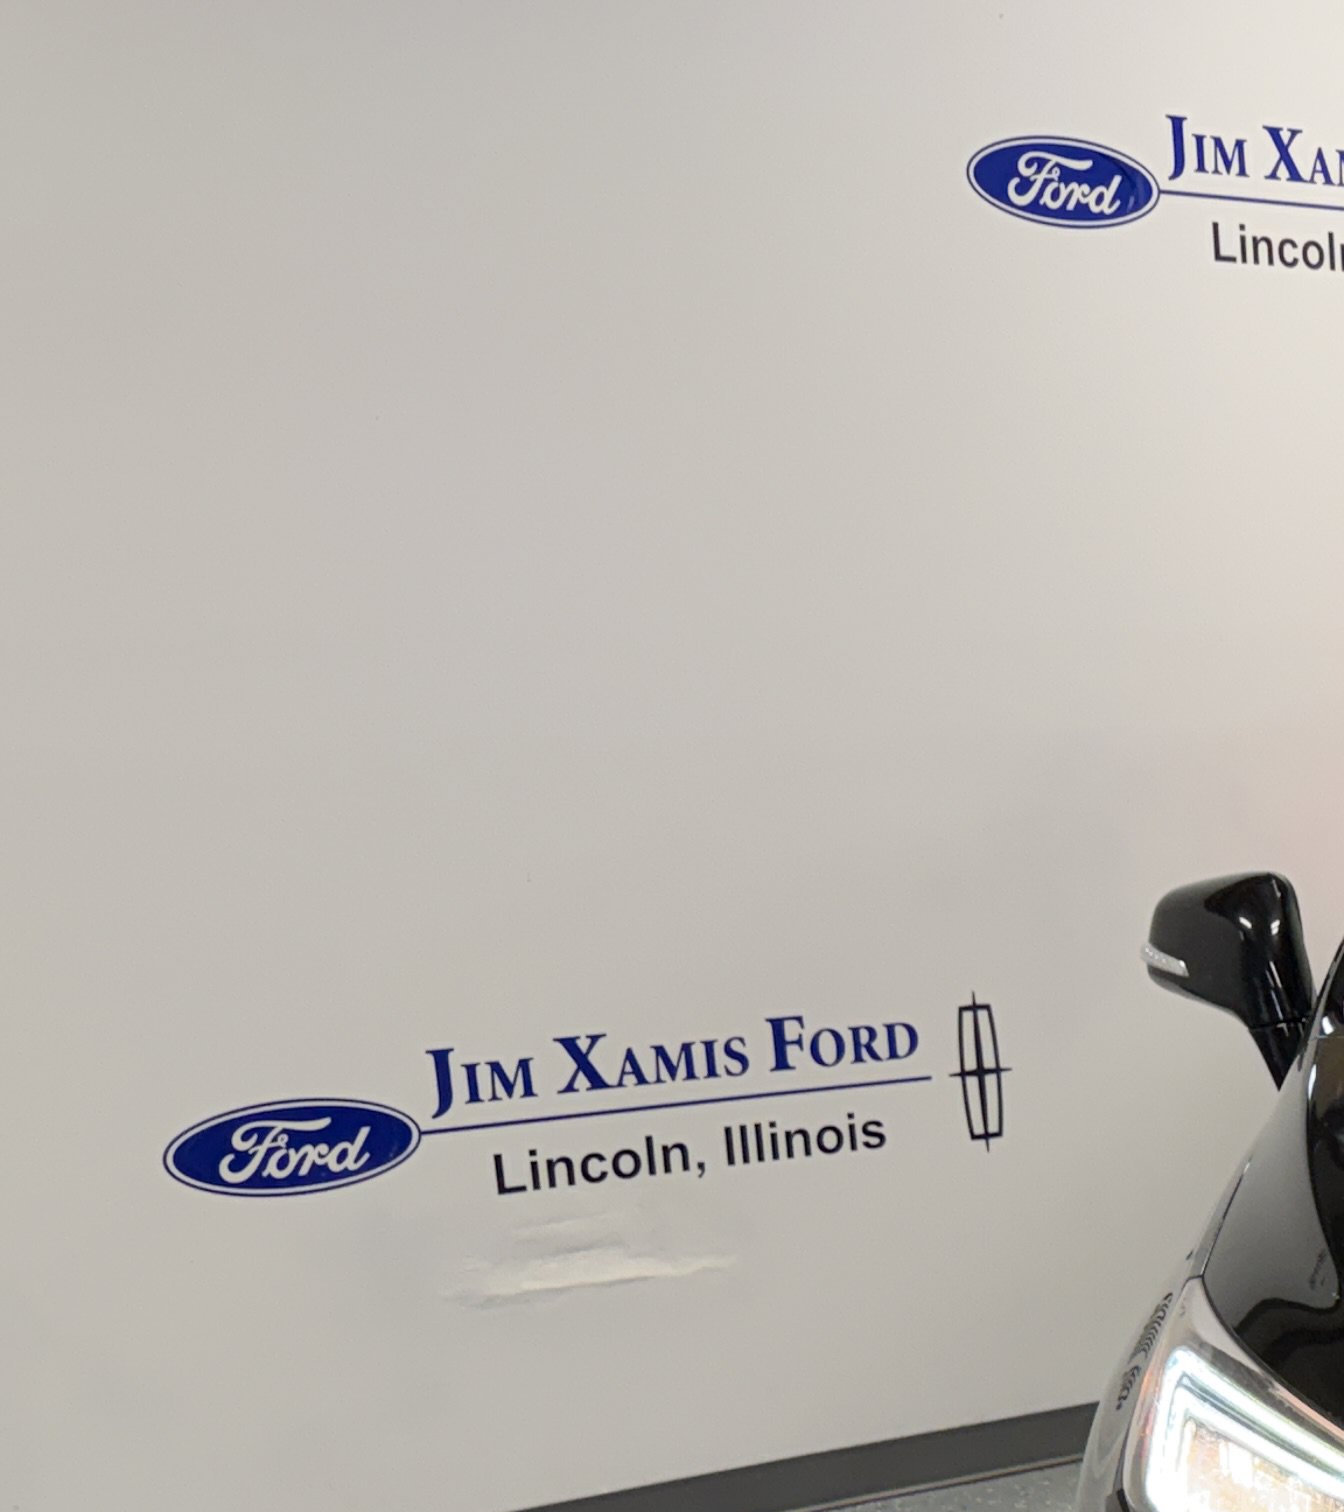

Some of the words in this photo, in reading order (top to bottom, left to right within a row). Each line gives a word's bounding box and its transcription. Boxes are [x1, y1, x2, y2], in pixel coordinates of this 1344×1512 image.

[1008, 150, 1122, 216] Ford
[220, 1117, 369, 1183] Ford
[493, 1136, 707, 1195] Lincoln,
[723, 1113, 887, 1168] Illinois
